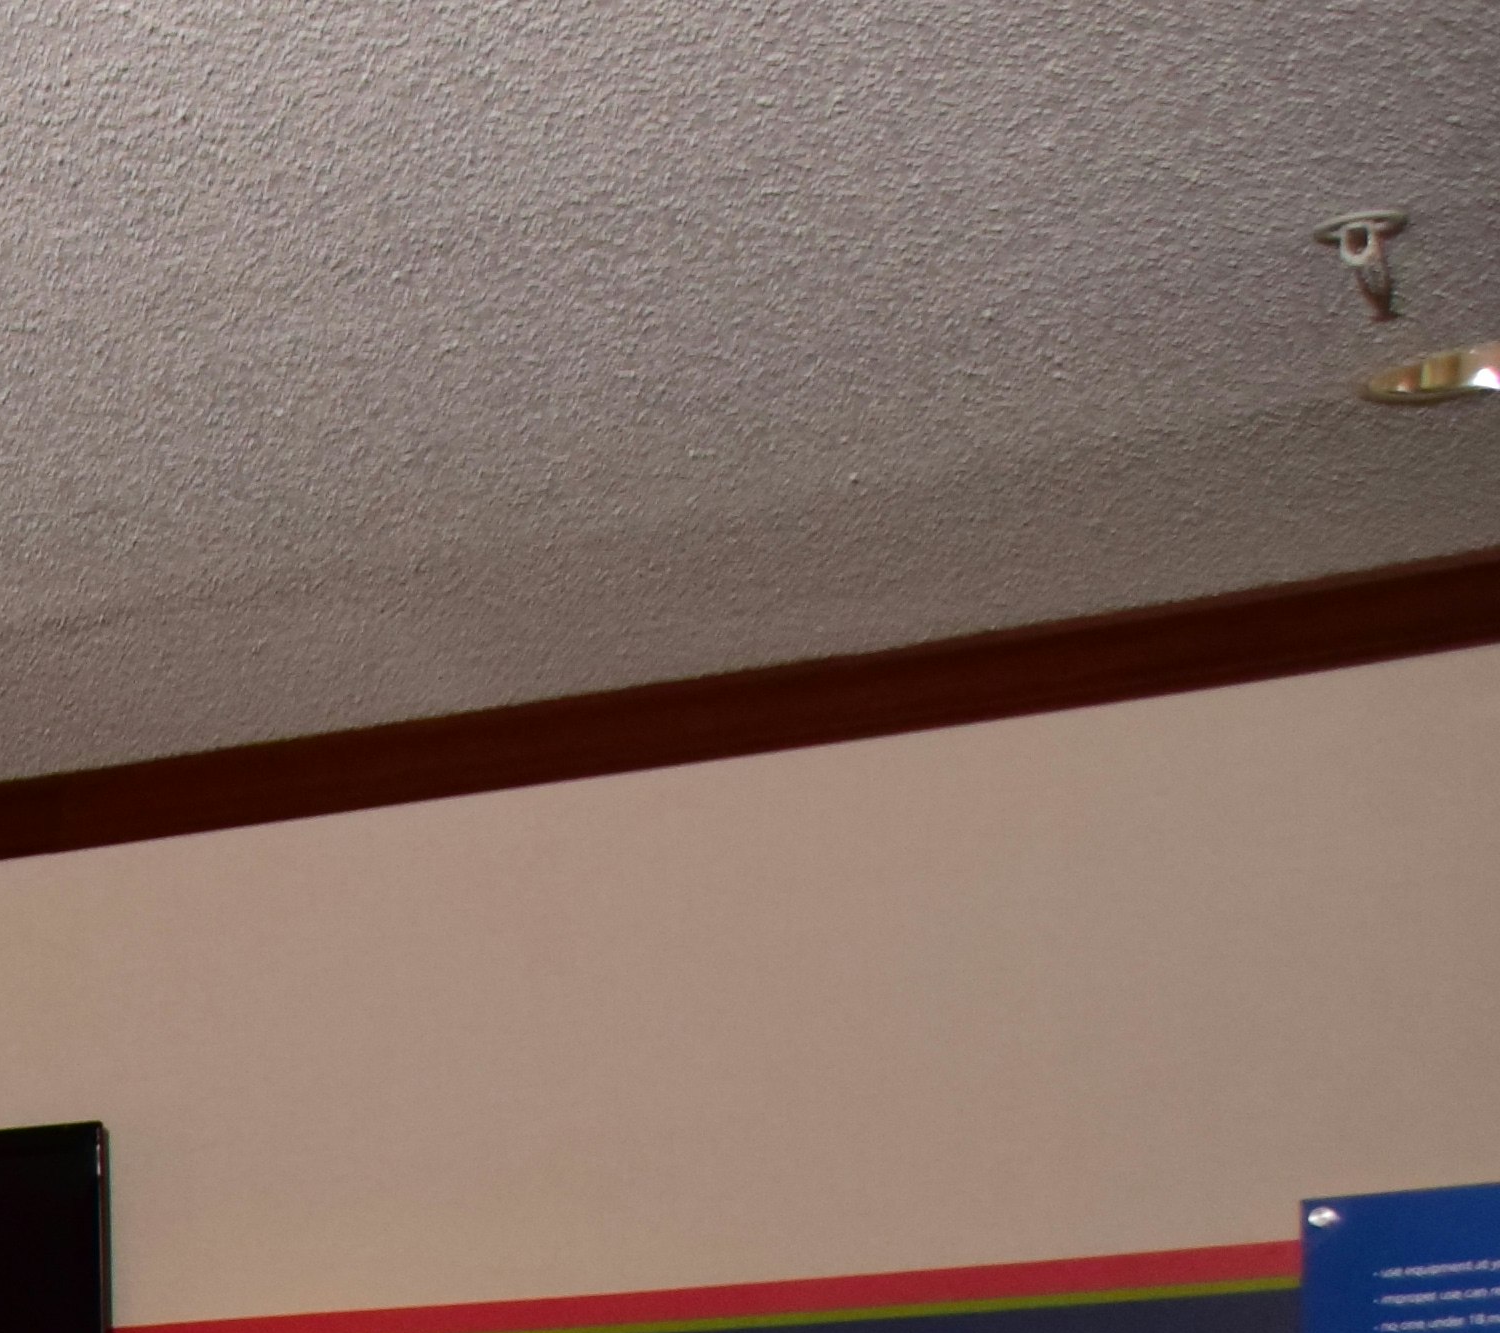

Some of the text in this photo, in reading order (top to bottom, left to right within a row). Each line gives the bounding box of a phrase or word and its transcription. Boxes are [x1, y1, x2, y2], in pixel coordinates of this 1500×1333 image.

[1404, 1261, 1473, 1277] equipment
[1380, 1322, 1398, 1333] no
[1400, 1320, 1424, 1331] one
[1427, 1316, 1465, 1329] under
[1469, 1313, 1484, 1326] 18
